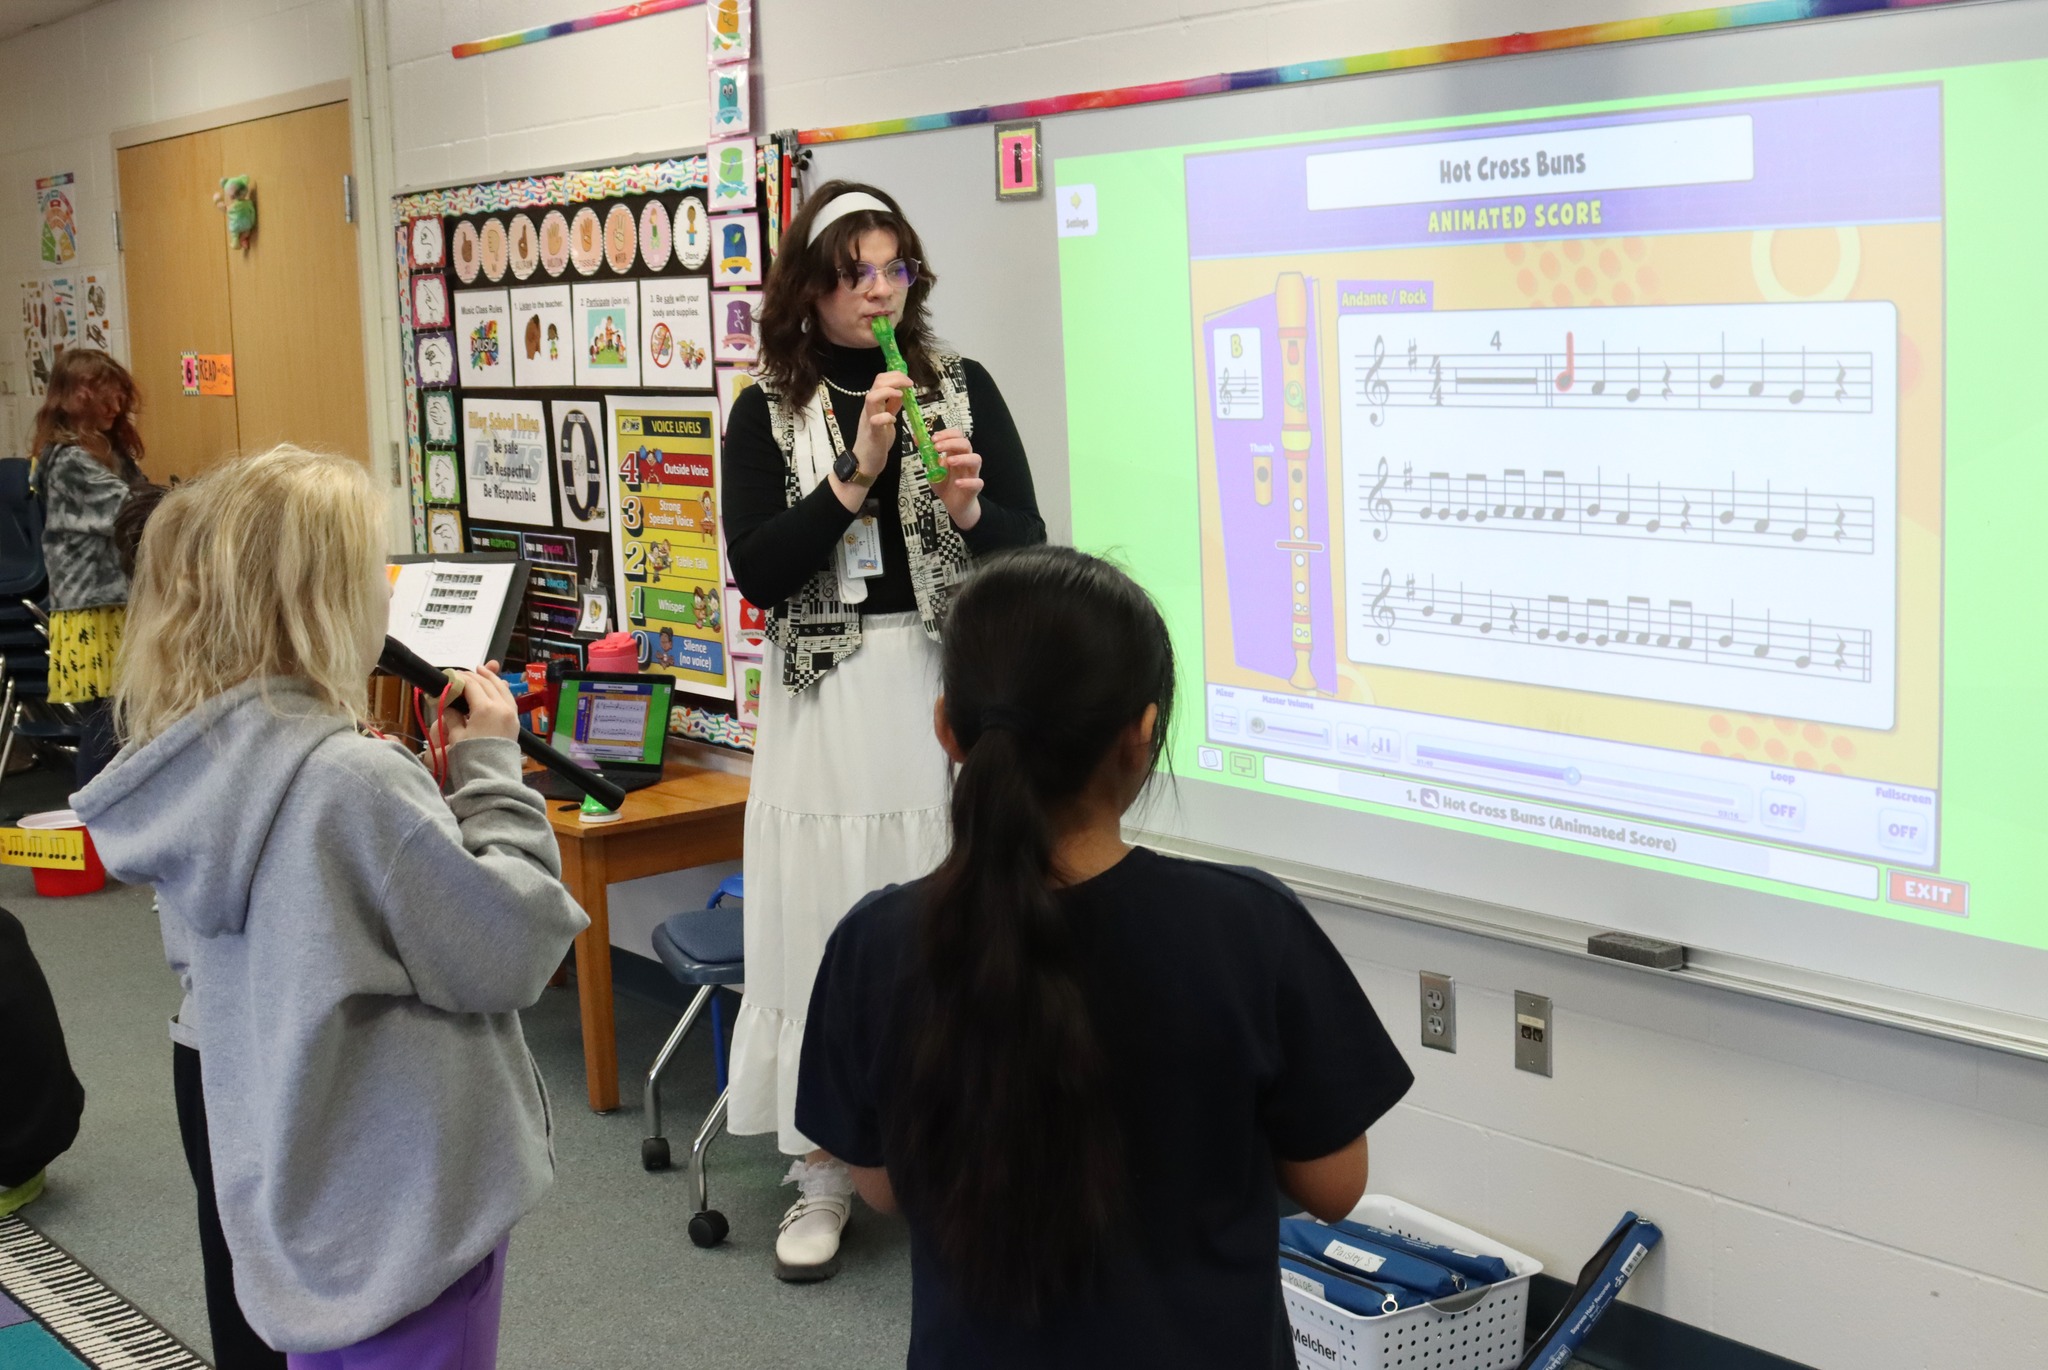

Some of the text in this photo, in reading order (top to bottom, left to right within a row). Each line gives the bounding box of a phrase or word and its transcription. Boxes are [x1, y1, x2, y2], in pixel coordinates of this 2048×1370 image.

[1440, 150, 1587, 184] Hot Cross Buns
[1428, 200, 1602, 233] ANIMATED SCORE
[656, 295, 663, 303] Be
[675, 294, 686, 302] with
[687, 294, 699, 304] your
[1341, 290, 1389, 307] Andante
[1399, 288, 1428, 305] Rock
[461, 304, 503, 315] Music Class Rules
[652, 309, 665, 318] body
[666, 308, 676, 316] and
[473, 338, 497, 352] MUSIC
[1229, 334, 1244, 359] B
[1490, 330, 1503, 351] 4
[651, 420, 702, 434] VOICE LEVELS
[494, 439, 519, 454] Be safe
[1249, 442, 1275, 454] Thumb
[484, 461, 532, 482] Be Respectful
[618, 451, 640, 485] 4
[663, 463, 709, 477] Outside Voice
[484, 483, 537, 504] Be Responsible
[621, 495, 642, 530] 3
[659, 500, 682, 514] Strong
[648, 513, 694, 528] Speaker Voice
[525, 541, 536, 552] YOU
[624, 541, 645, 576] 2
[675, 555, 709, 570] Table Talk
[629, 585, 644, 620] 1
[658, 599, 685, 614] Whisper
[683, 639, 707, 654] Silence
[680, 652, 712, 670] (no voice)
[527, 669, 541, 680] Yoga
[1261, 694, 1314, 710] Master Volume
[1770, 770, 1796, 785] Loop
[1875, 787, 1932, 806] Fullscreen
[1769, 803, 1797, 819] OFF
[1405, 789, 1678, 853] 1. Hot Cross Buns (Animated Score)
[1888, 823, 1919, 840] OFF
[1905, 880, 1953, 904] EXIT
[1332, 1245, 1364, 1266] Paisley
[1290, 1325, 1337, 1362] Melcher
